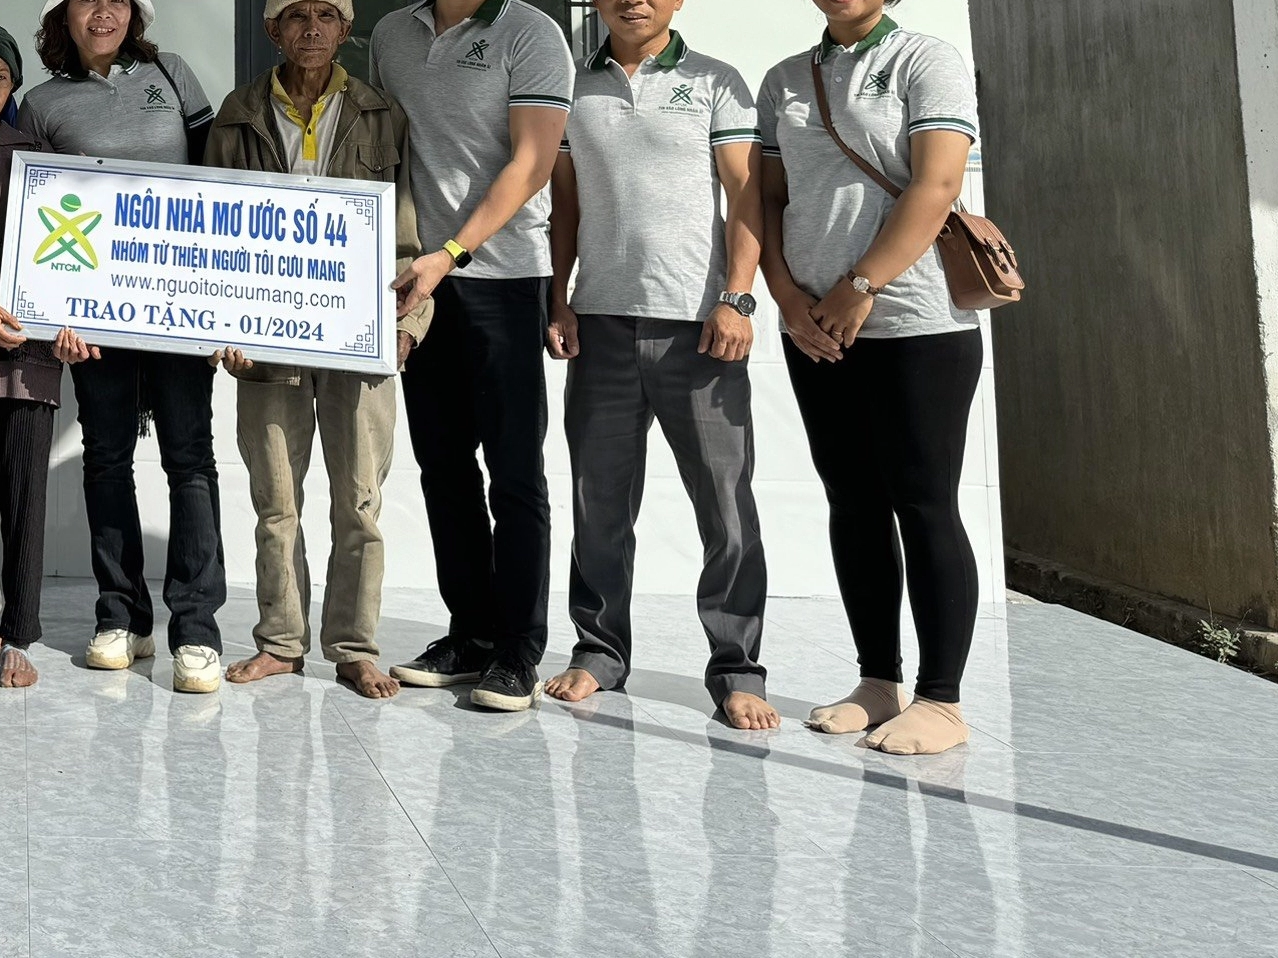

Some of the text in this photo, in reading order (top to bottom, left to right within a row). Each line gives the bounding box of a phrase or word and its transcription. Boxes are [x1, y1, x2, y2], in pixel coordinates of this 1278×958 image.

[114, 187, 348, 248] NGÔI NHÀ MƠ ƯỚC SỐ 44
[50, 262, 82, 273] NTCM
[110, 236, 346, 283] NHÓM TỪ THIỆN NGƯỜI TÔI CƯU MANG
[110, 273, 346, 310] www.nguoitoicuumang.com
[65, 296, 137, 323] TRAO
[143, 300, 217, 332] TẶNG
[239, 314, 325, 342] 01/2024
